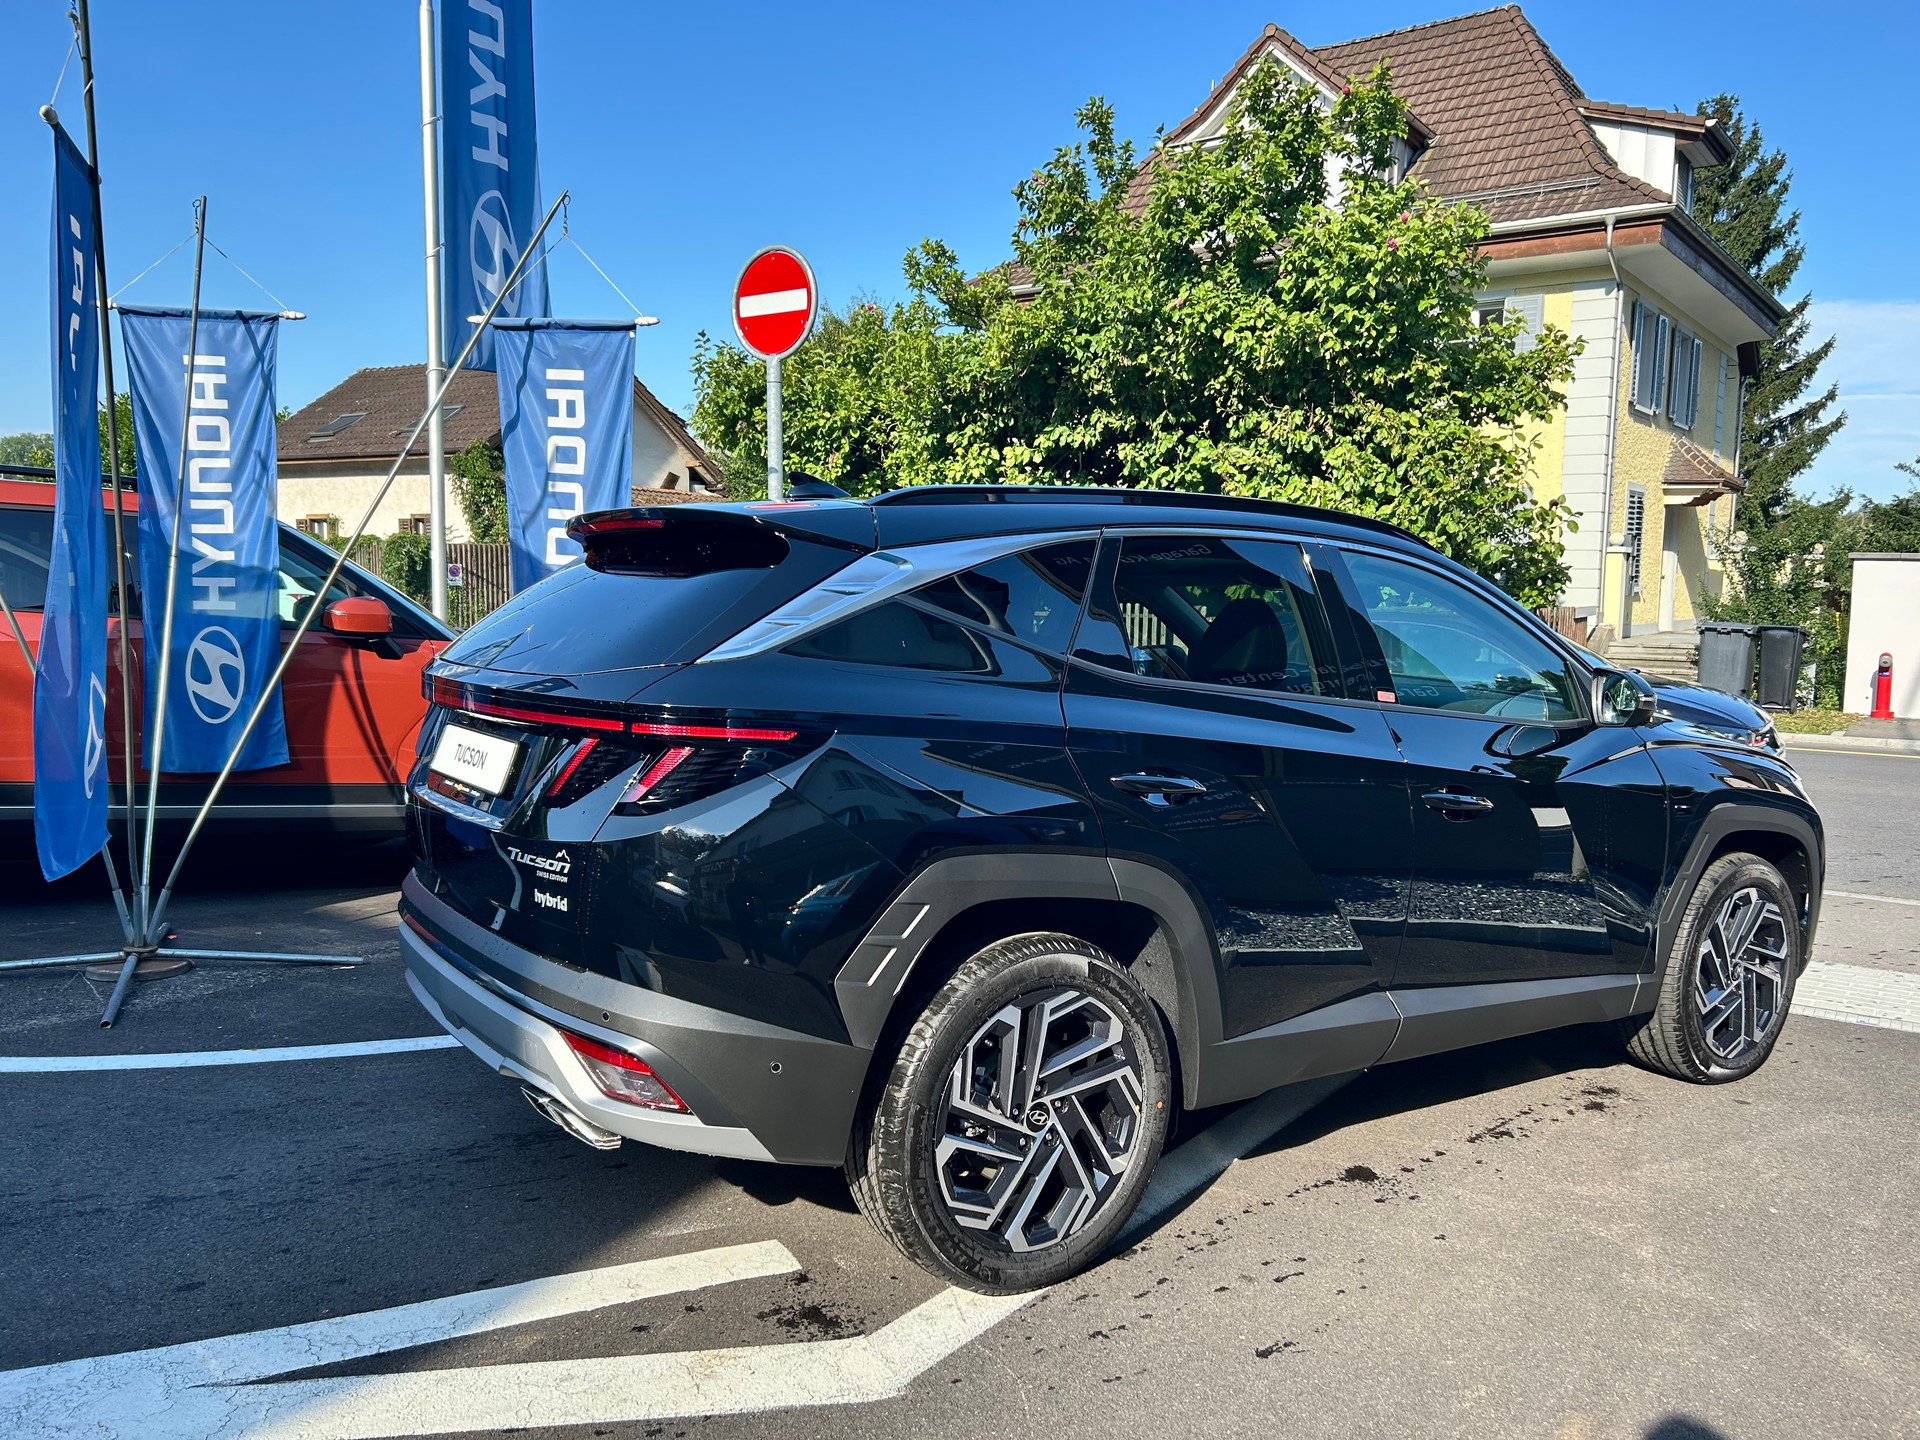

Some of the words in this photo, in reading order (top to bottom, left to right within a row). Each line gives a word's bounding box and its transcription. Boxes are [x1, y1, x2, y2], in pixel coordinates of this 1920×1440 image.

[182, 354, 236, 611] HYUNDAI
[454, 743, 488, 770] TUCSON
[534, 888, 568, 912] hybrid
